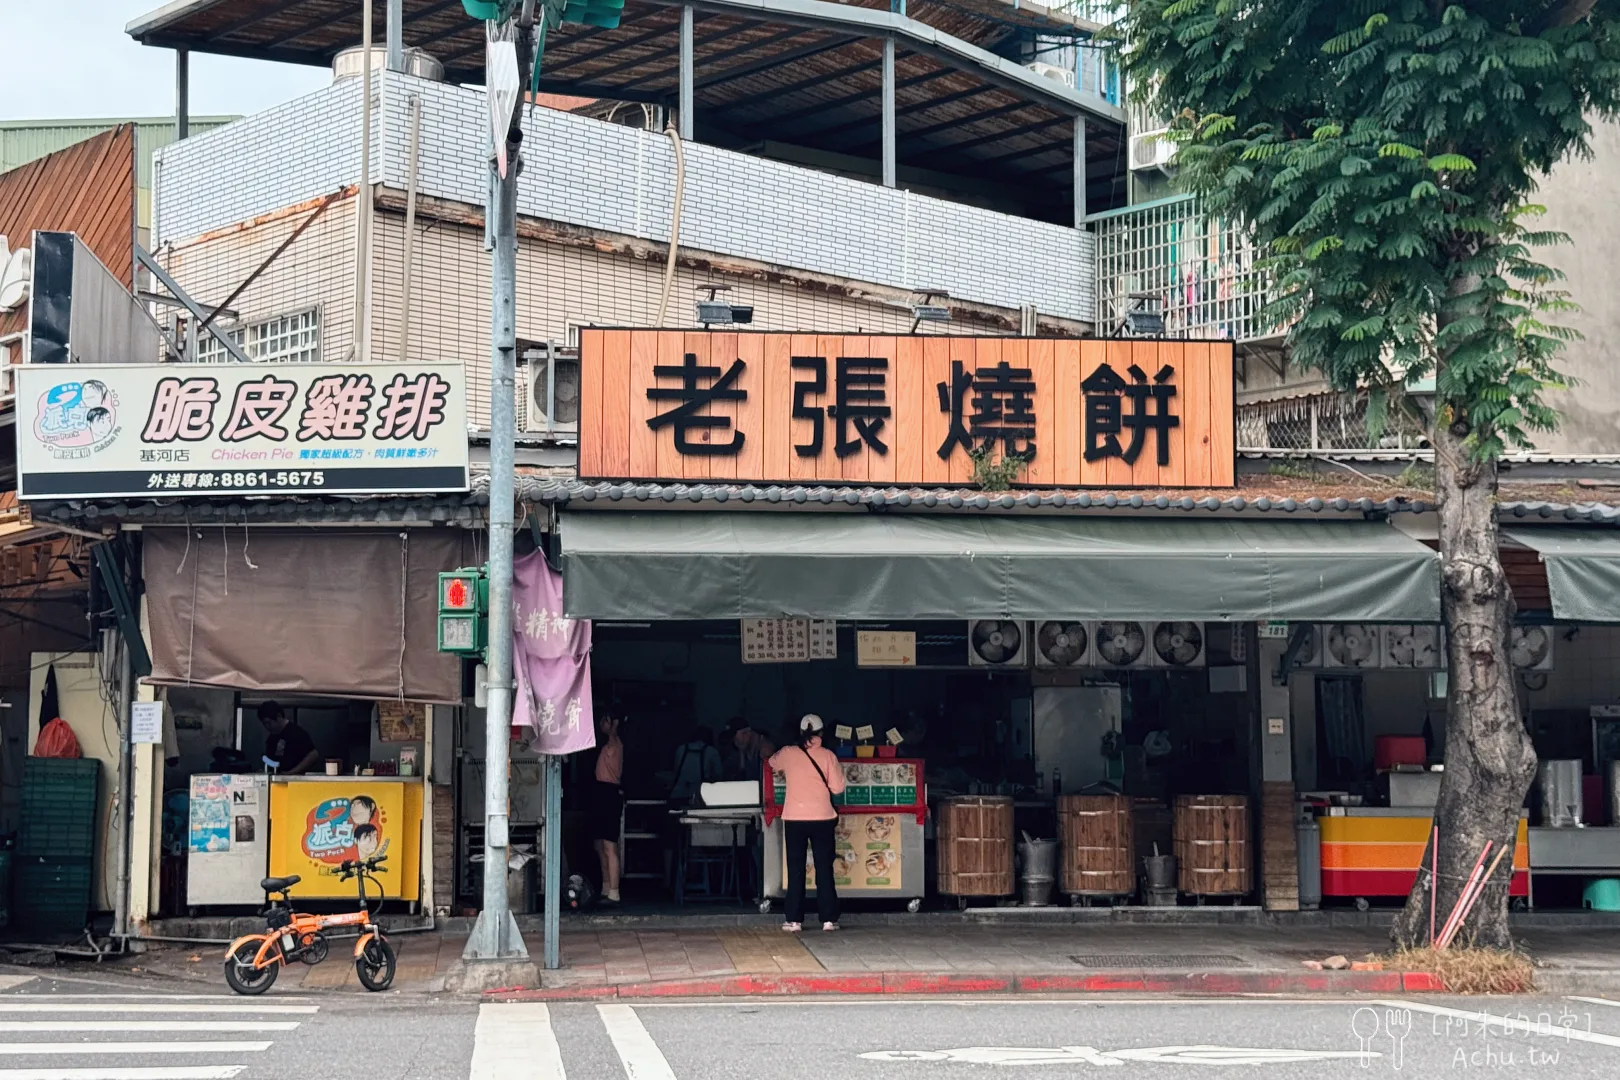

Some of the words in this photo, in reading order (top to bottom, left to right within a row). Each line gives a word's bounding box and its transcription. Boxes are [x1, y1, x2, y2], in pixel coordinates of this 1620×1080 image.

[140, 373, 450, 442] 脆皮雞排
[646, 353, 1180, 467] 老張燒餅
[140, 449, 190, 462] 基河店
[211, 448, 268, 461] Chicken
[271, 448, 294, 460] Pie
[309, 821, 354, 848] 派克
[309, 850, 326, 858] Two
